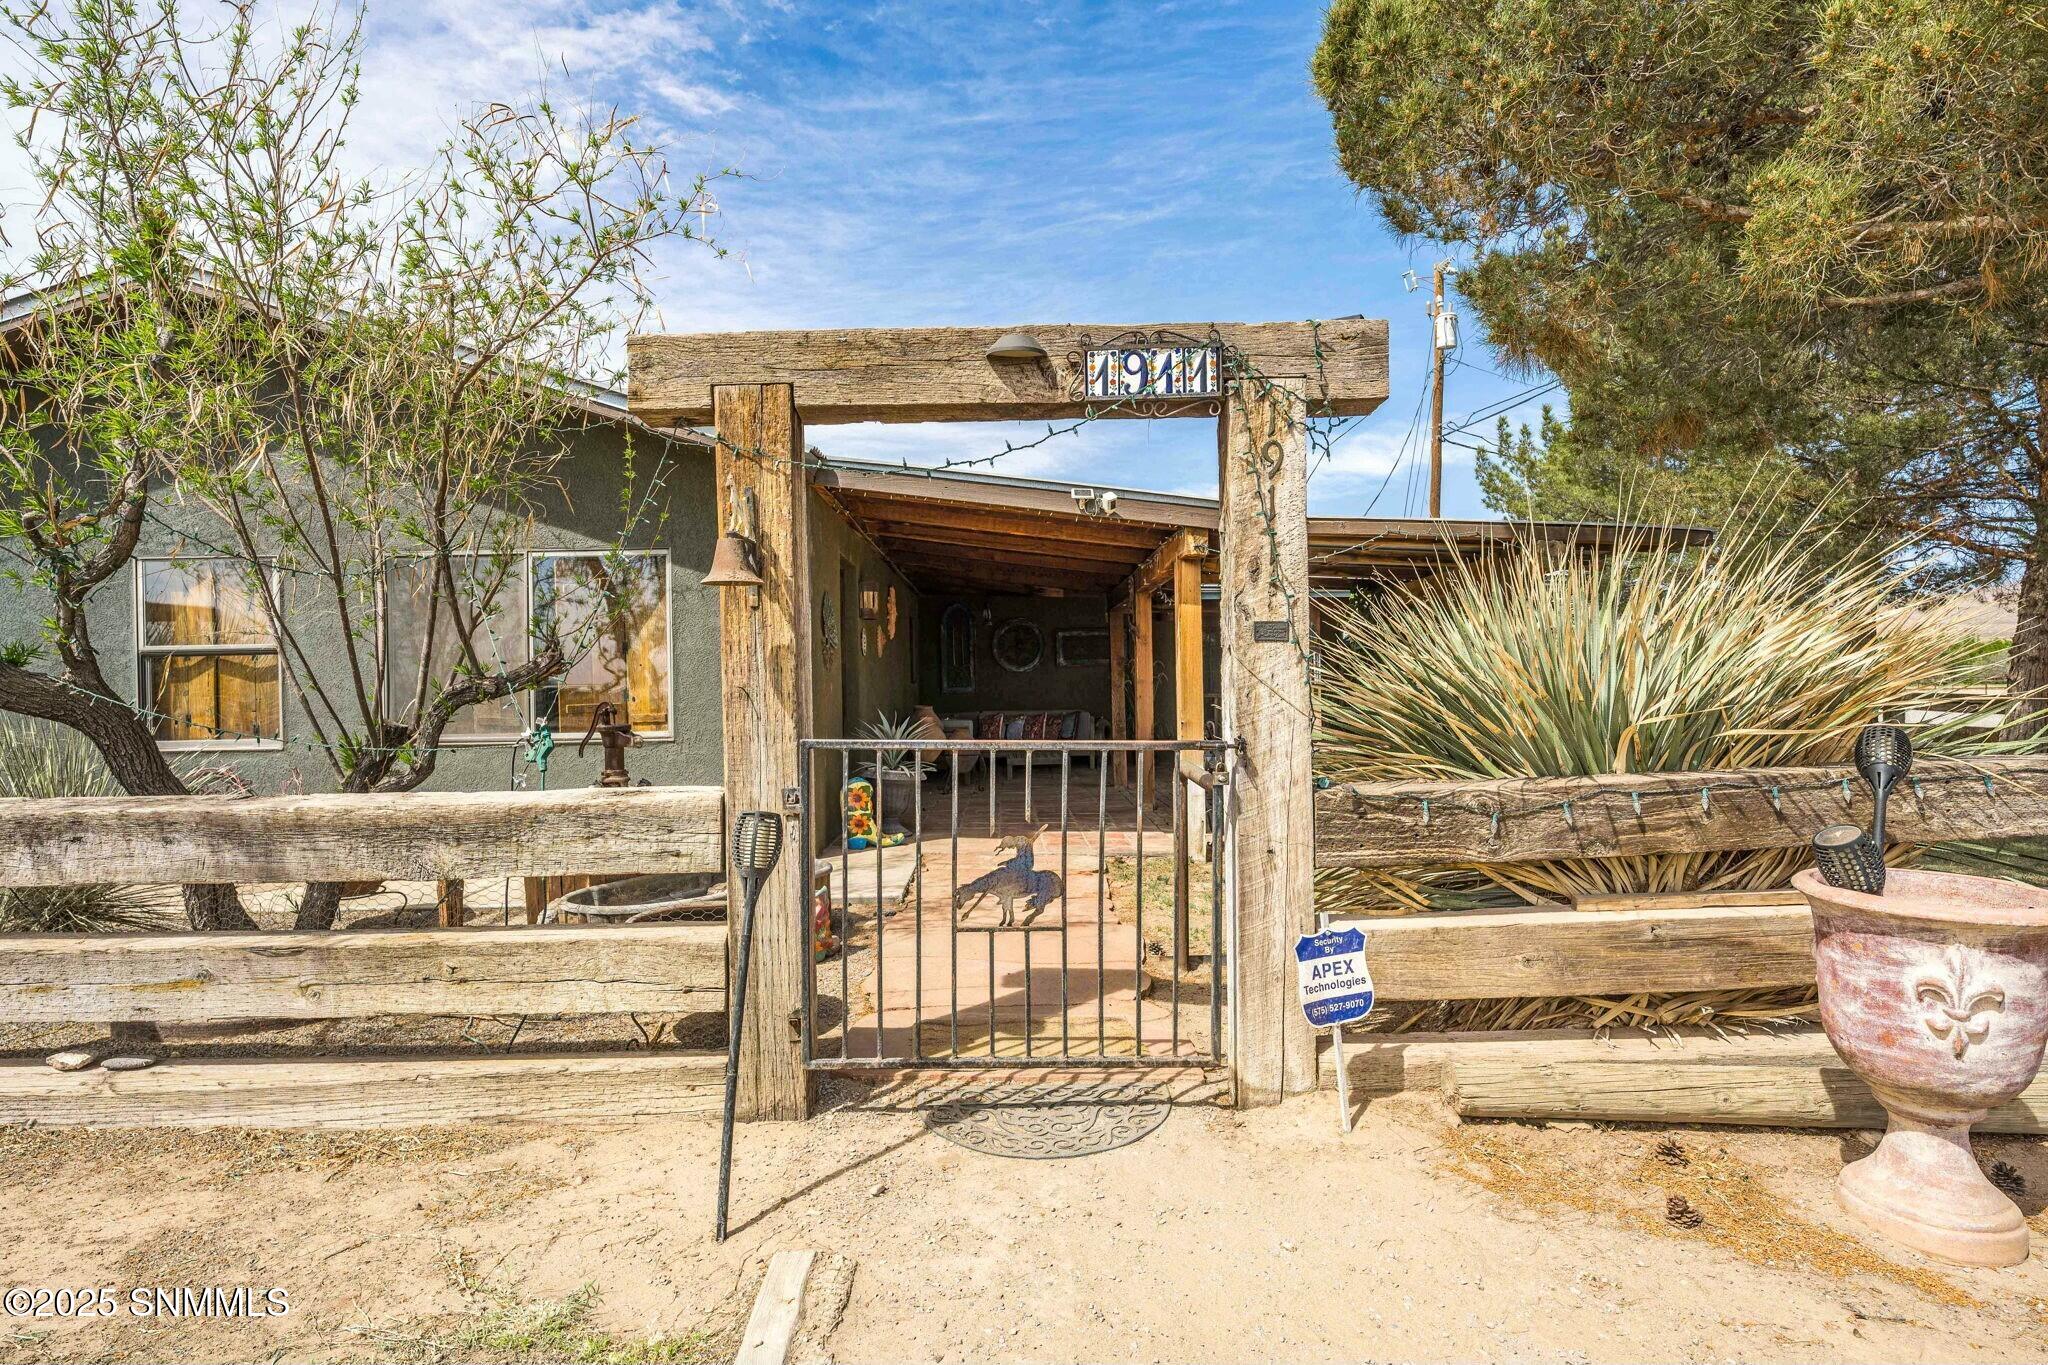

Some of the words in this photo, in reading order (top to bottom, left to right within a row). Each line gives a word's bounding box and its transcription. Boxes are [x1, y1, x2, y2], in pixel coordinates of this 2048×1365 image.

[1094, 350, 1208, 394] 1911
[1314, 936, 1343, 947] Security
[1324, 946, 1335, 954] By
[1312, 959, 1354, 980] APEX
[1303, 976, 1367, 995] Technologies
[1329, 998, 1364, 1012] 527-9070
